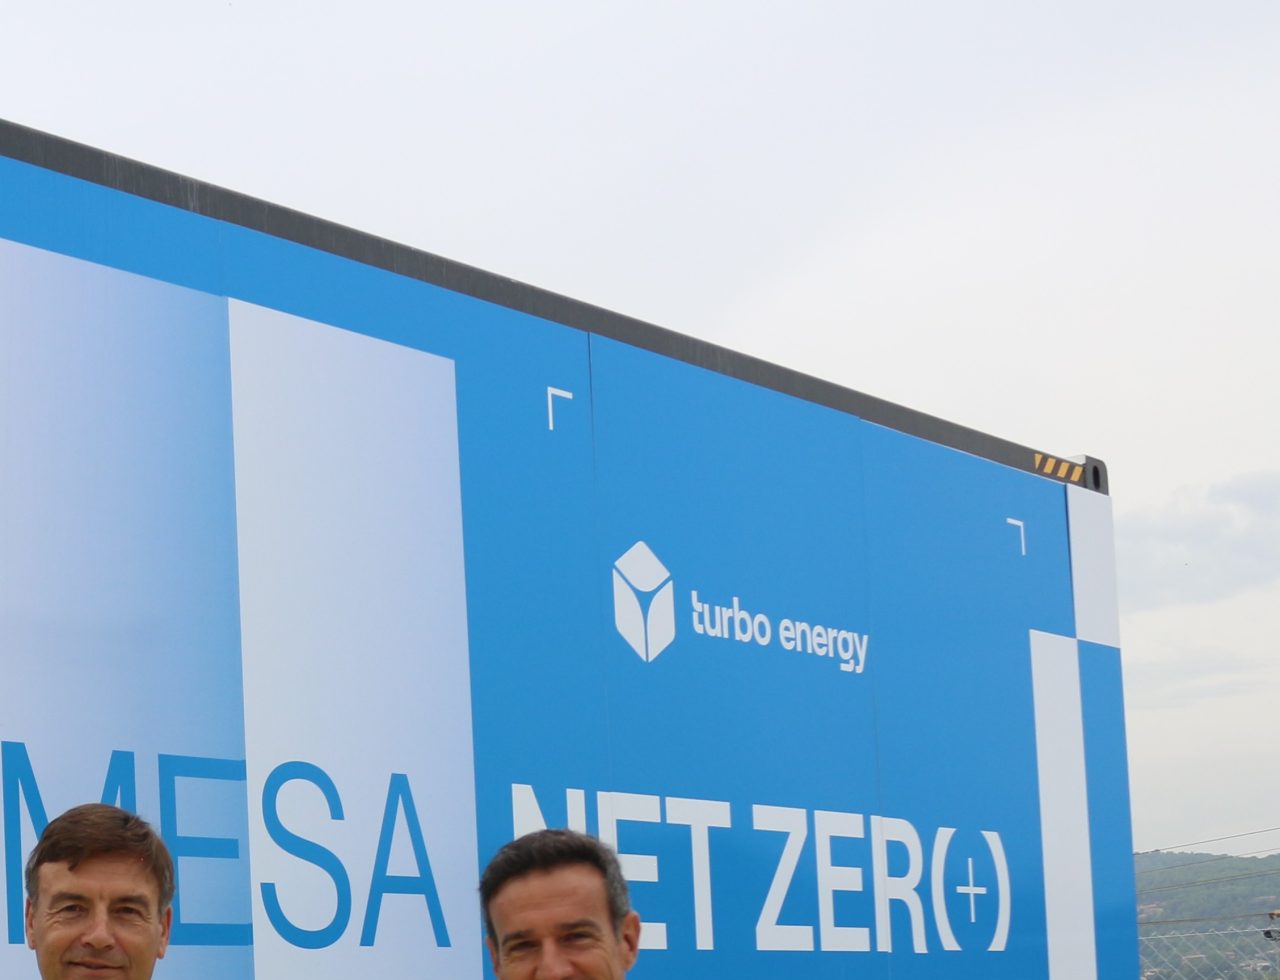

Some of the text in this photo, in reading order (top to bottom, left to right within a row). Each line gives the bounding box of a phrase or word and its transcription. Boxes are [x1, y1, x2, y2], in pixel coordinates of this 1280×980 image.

[691, 590, 869, 674] turbo energy
[751, 804, 1011, 953] ZER(+)
